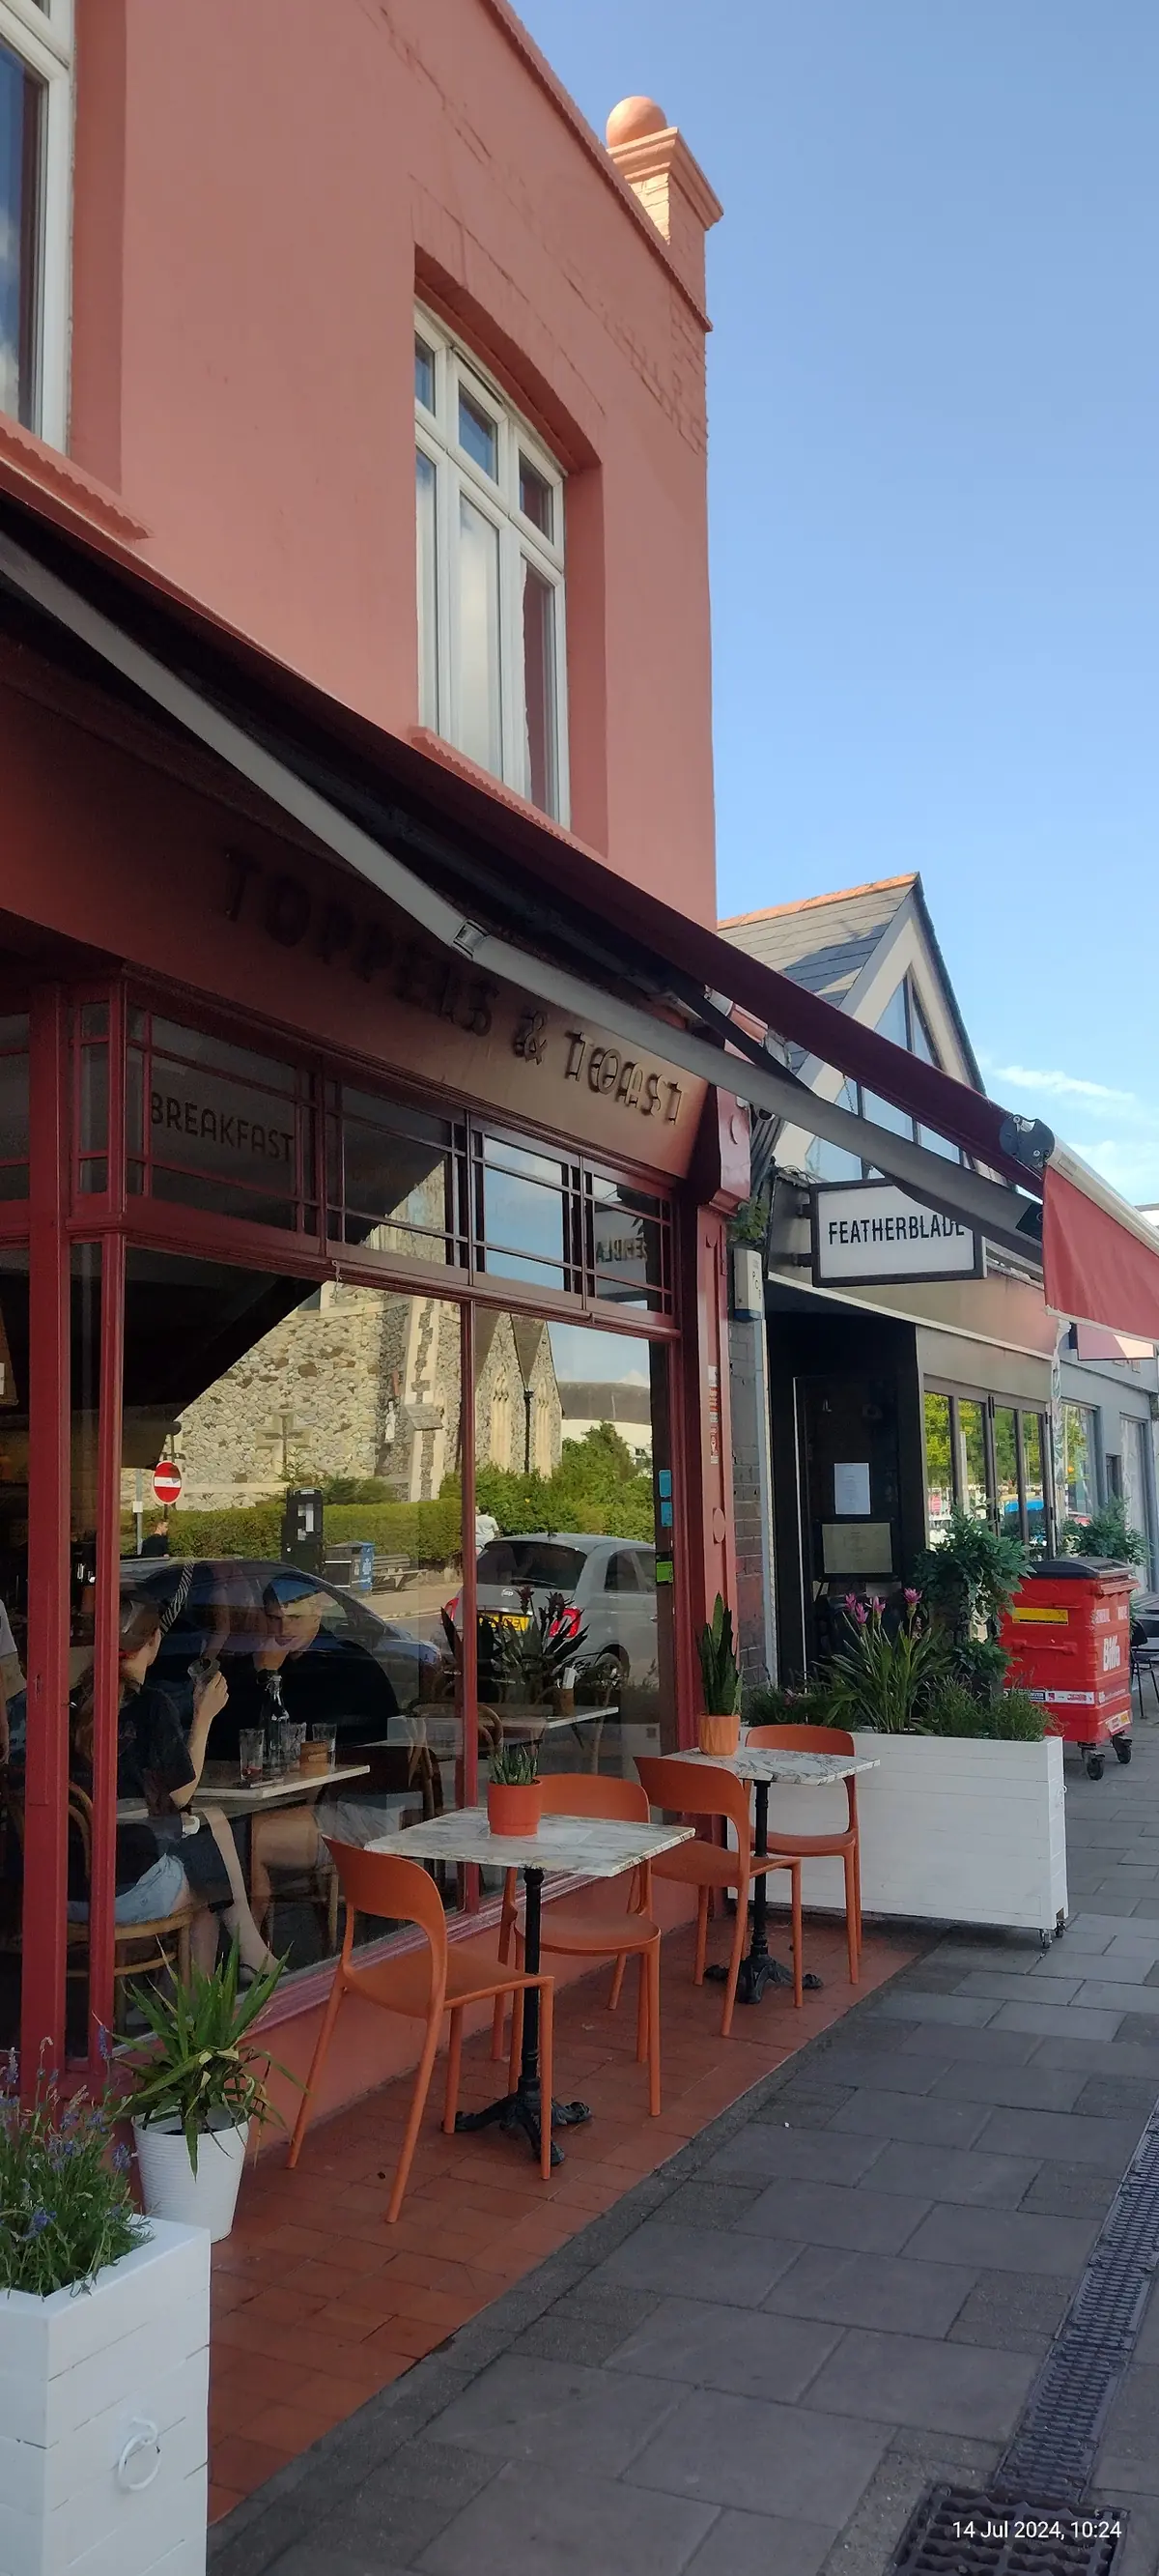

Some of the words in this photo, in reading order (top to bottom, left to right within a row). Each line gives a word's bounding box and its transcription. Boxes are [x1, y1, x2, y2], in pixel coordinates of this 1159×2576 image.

[222, 845, 500, 1037] TOPPERS
[514, 1007, 548, 1065] &
[566, 1030, 689, 1125] TOAST
[151, 1091, 294, 1161] BREAKFAST
